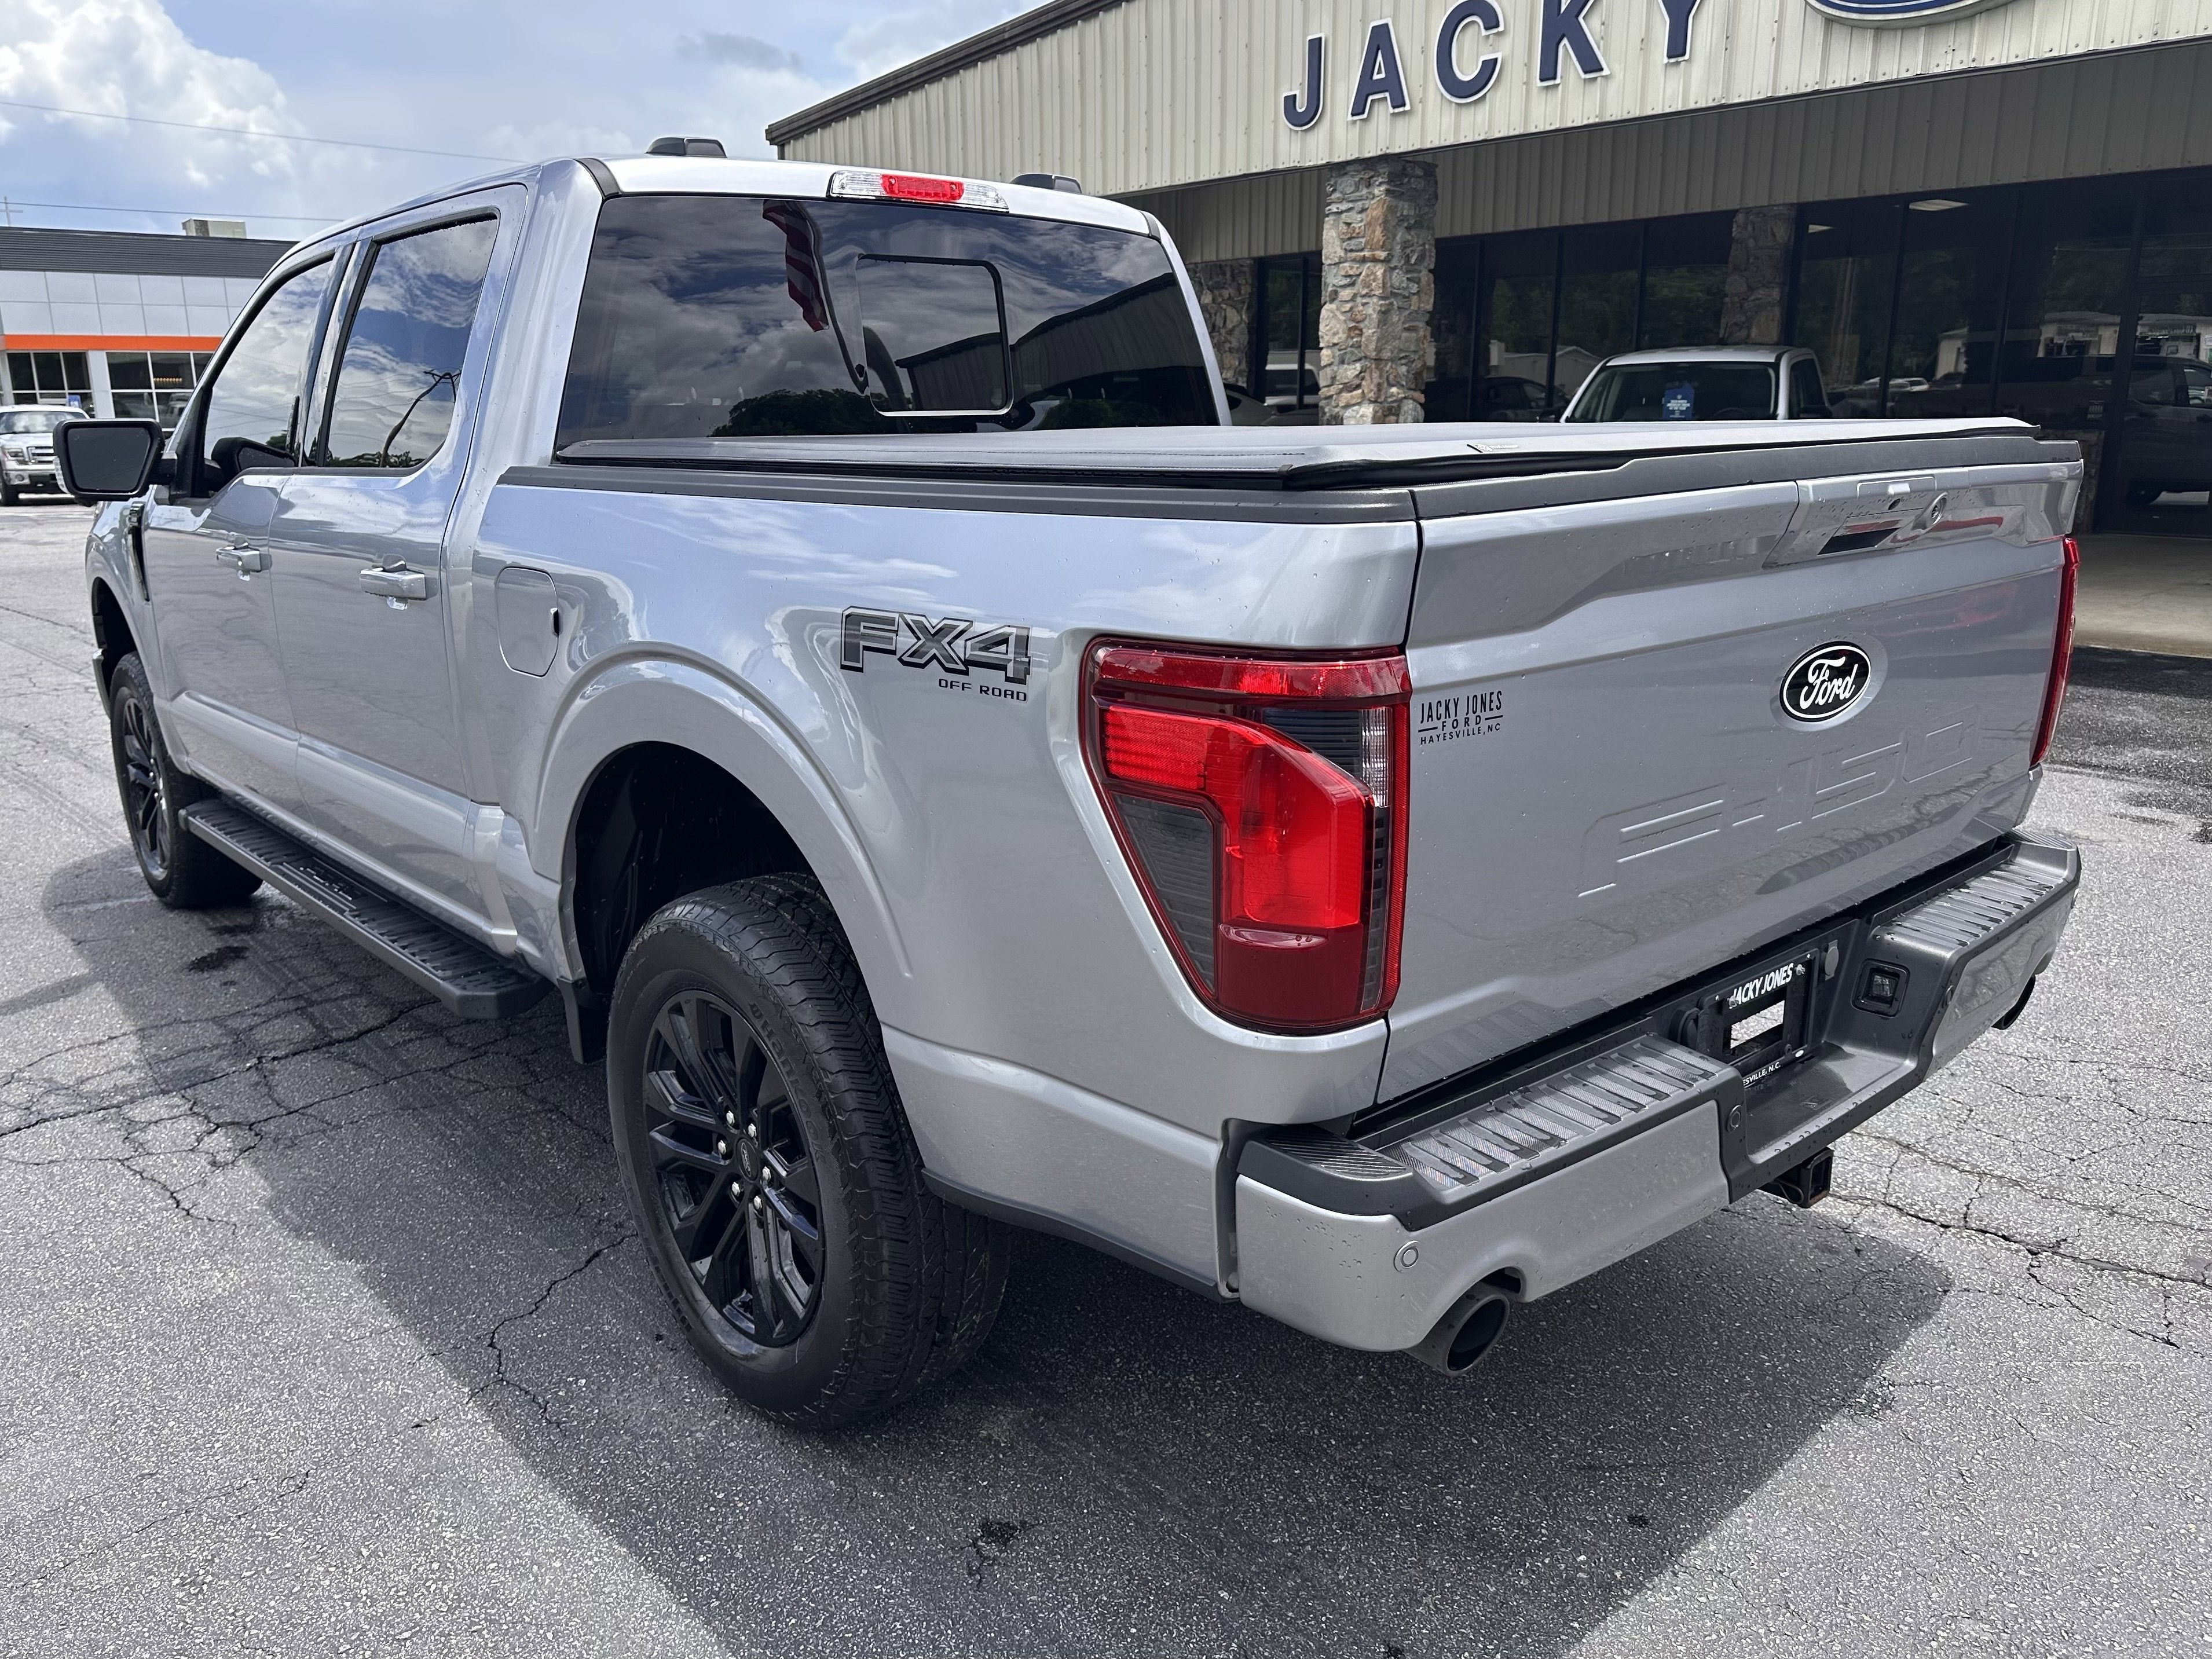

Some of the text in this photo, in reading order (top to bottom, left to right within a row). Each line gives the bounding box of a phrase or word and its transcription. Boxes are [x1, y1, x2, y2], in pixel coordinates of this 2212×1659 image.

[1283, 0, 1700, 131] JACKY
[840, 606, 1031, 685] FX4
[938, 679, 1027, 702] OFF ROAD
[1800, 656, 1859, 710] Ford
[1420, 690, 1502, 723] JACKY JONES
[1420, 723, 1500, 745] HAYESVILLE, NC
[1442, 715, 1481, 731] FORD
[1761, 962, 1794, 994] JONES
[1768, 1061, 1781, 1072] N.C.
